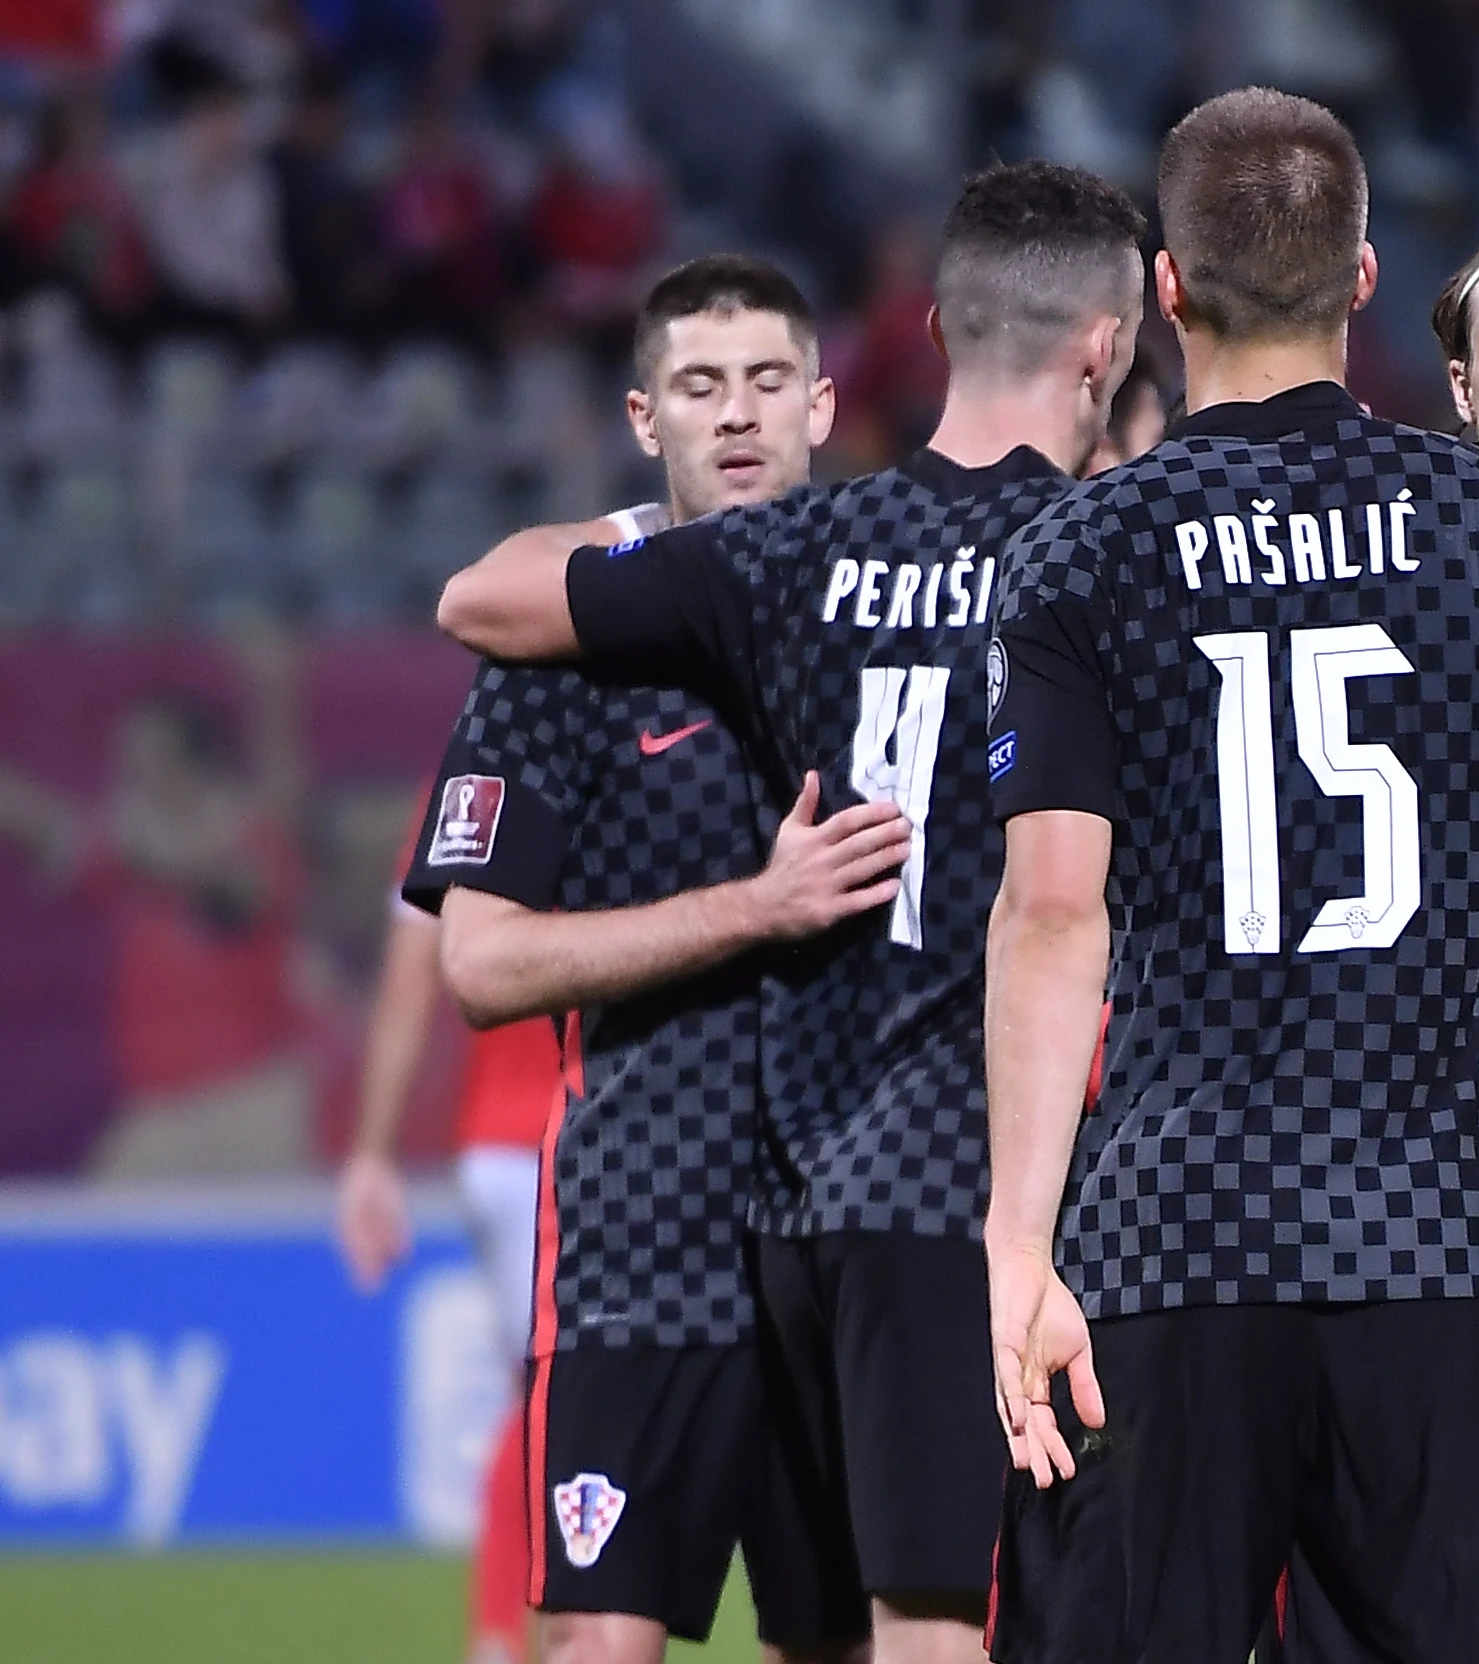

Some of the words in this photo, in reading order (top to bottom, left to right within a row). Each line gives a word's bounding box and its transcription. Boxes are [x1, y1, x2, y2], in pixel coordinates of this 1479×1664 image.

[822, 546, 996, 629] PERIŠI
[1175, 488, 1421, 590] PAŠALIĆ
[1192, 623, 1421, 955] 15
